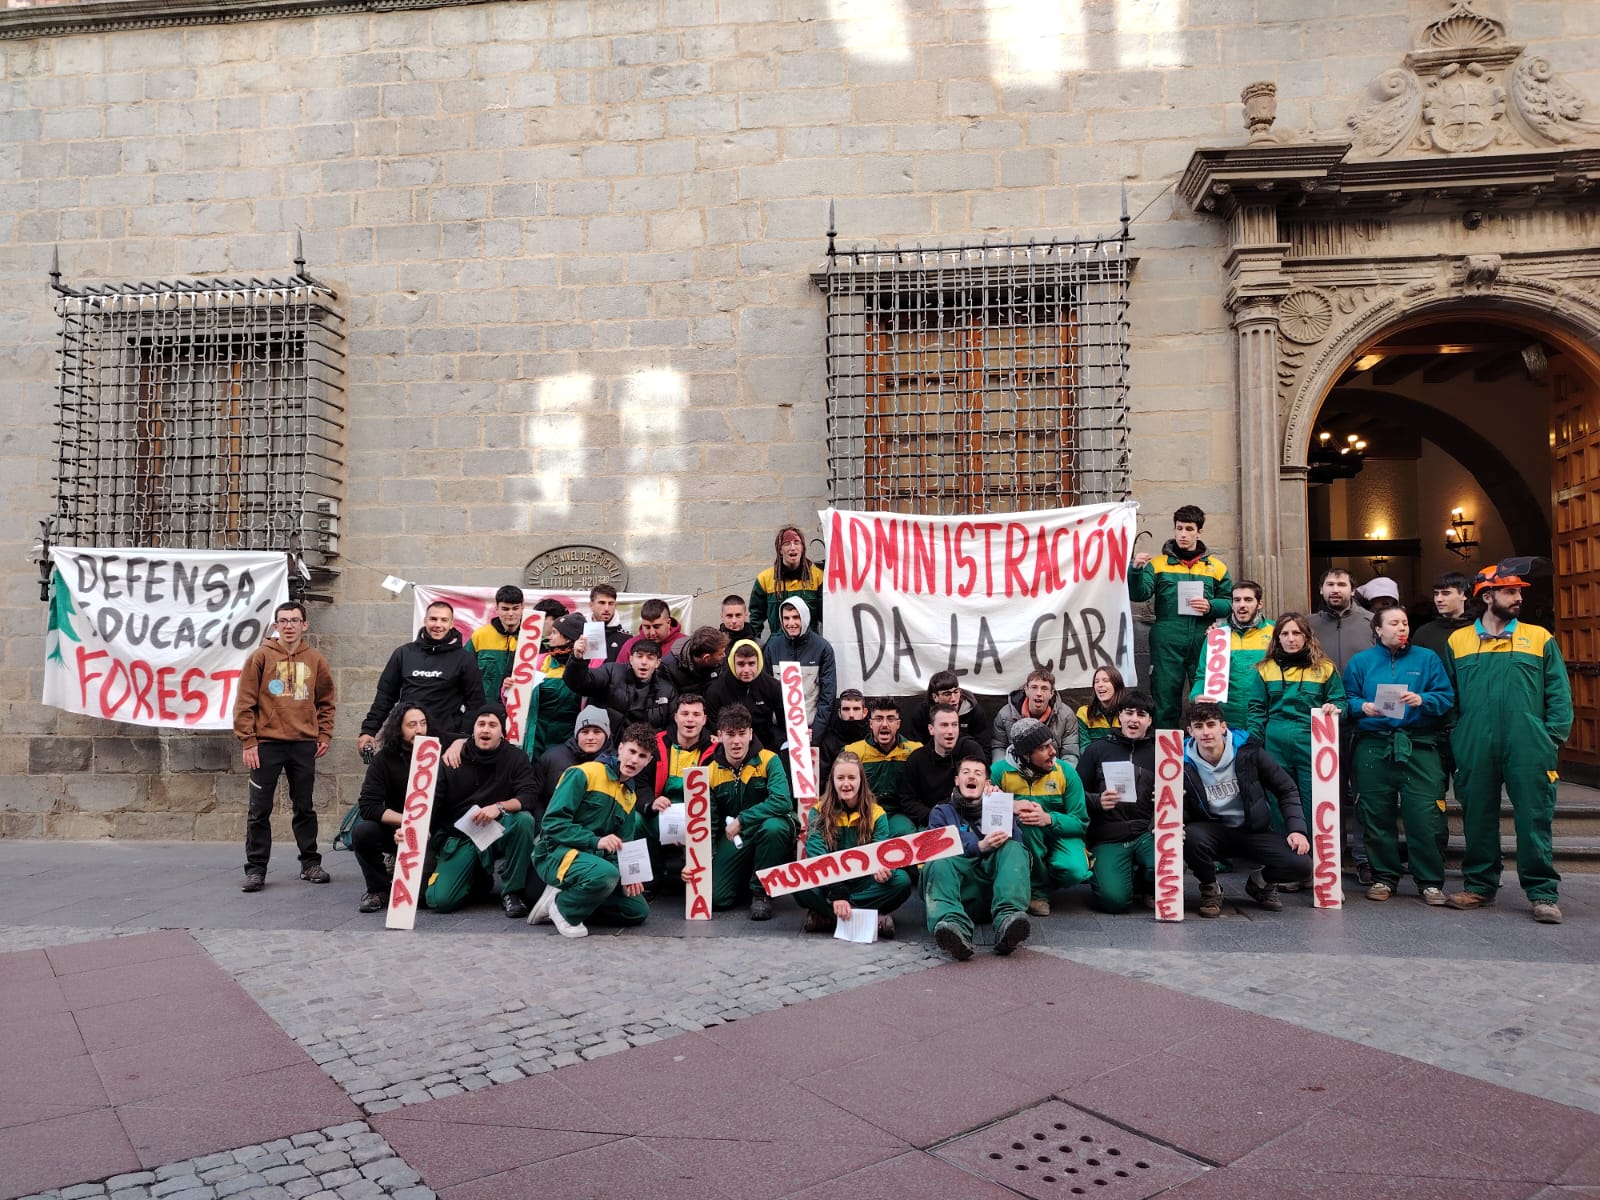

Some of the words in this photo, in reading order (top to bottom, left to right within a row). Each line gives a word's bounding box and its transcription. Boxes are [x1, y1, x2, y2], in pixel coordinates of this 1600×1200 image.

[73, 554, 255, 612] DEFENSA
[540, 577, 573, 588] ALTITUD
[553, 564, 596, 576] SOMPORT
[561, 551, 579, 562] NIVEL
[580, 551, 589, 562] DE
[78, 599, 269, 650] DUCACIÓ
[852, 603, 921, 682] DA
[948, 613, 1003, 676] LA
[1030, 608, 1129, 671] CARA
[1207, 629, 1227, 695] SOS
[1312, 713, 1338, 782] NO
[1314, 801, 1340, 908] CESE
